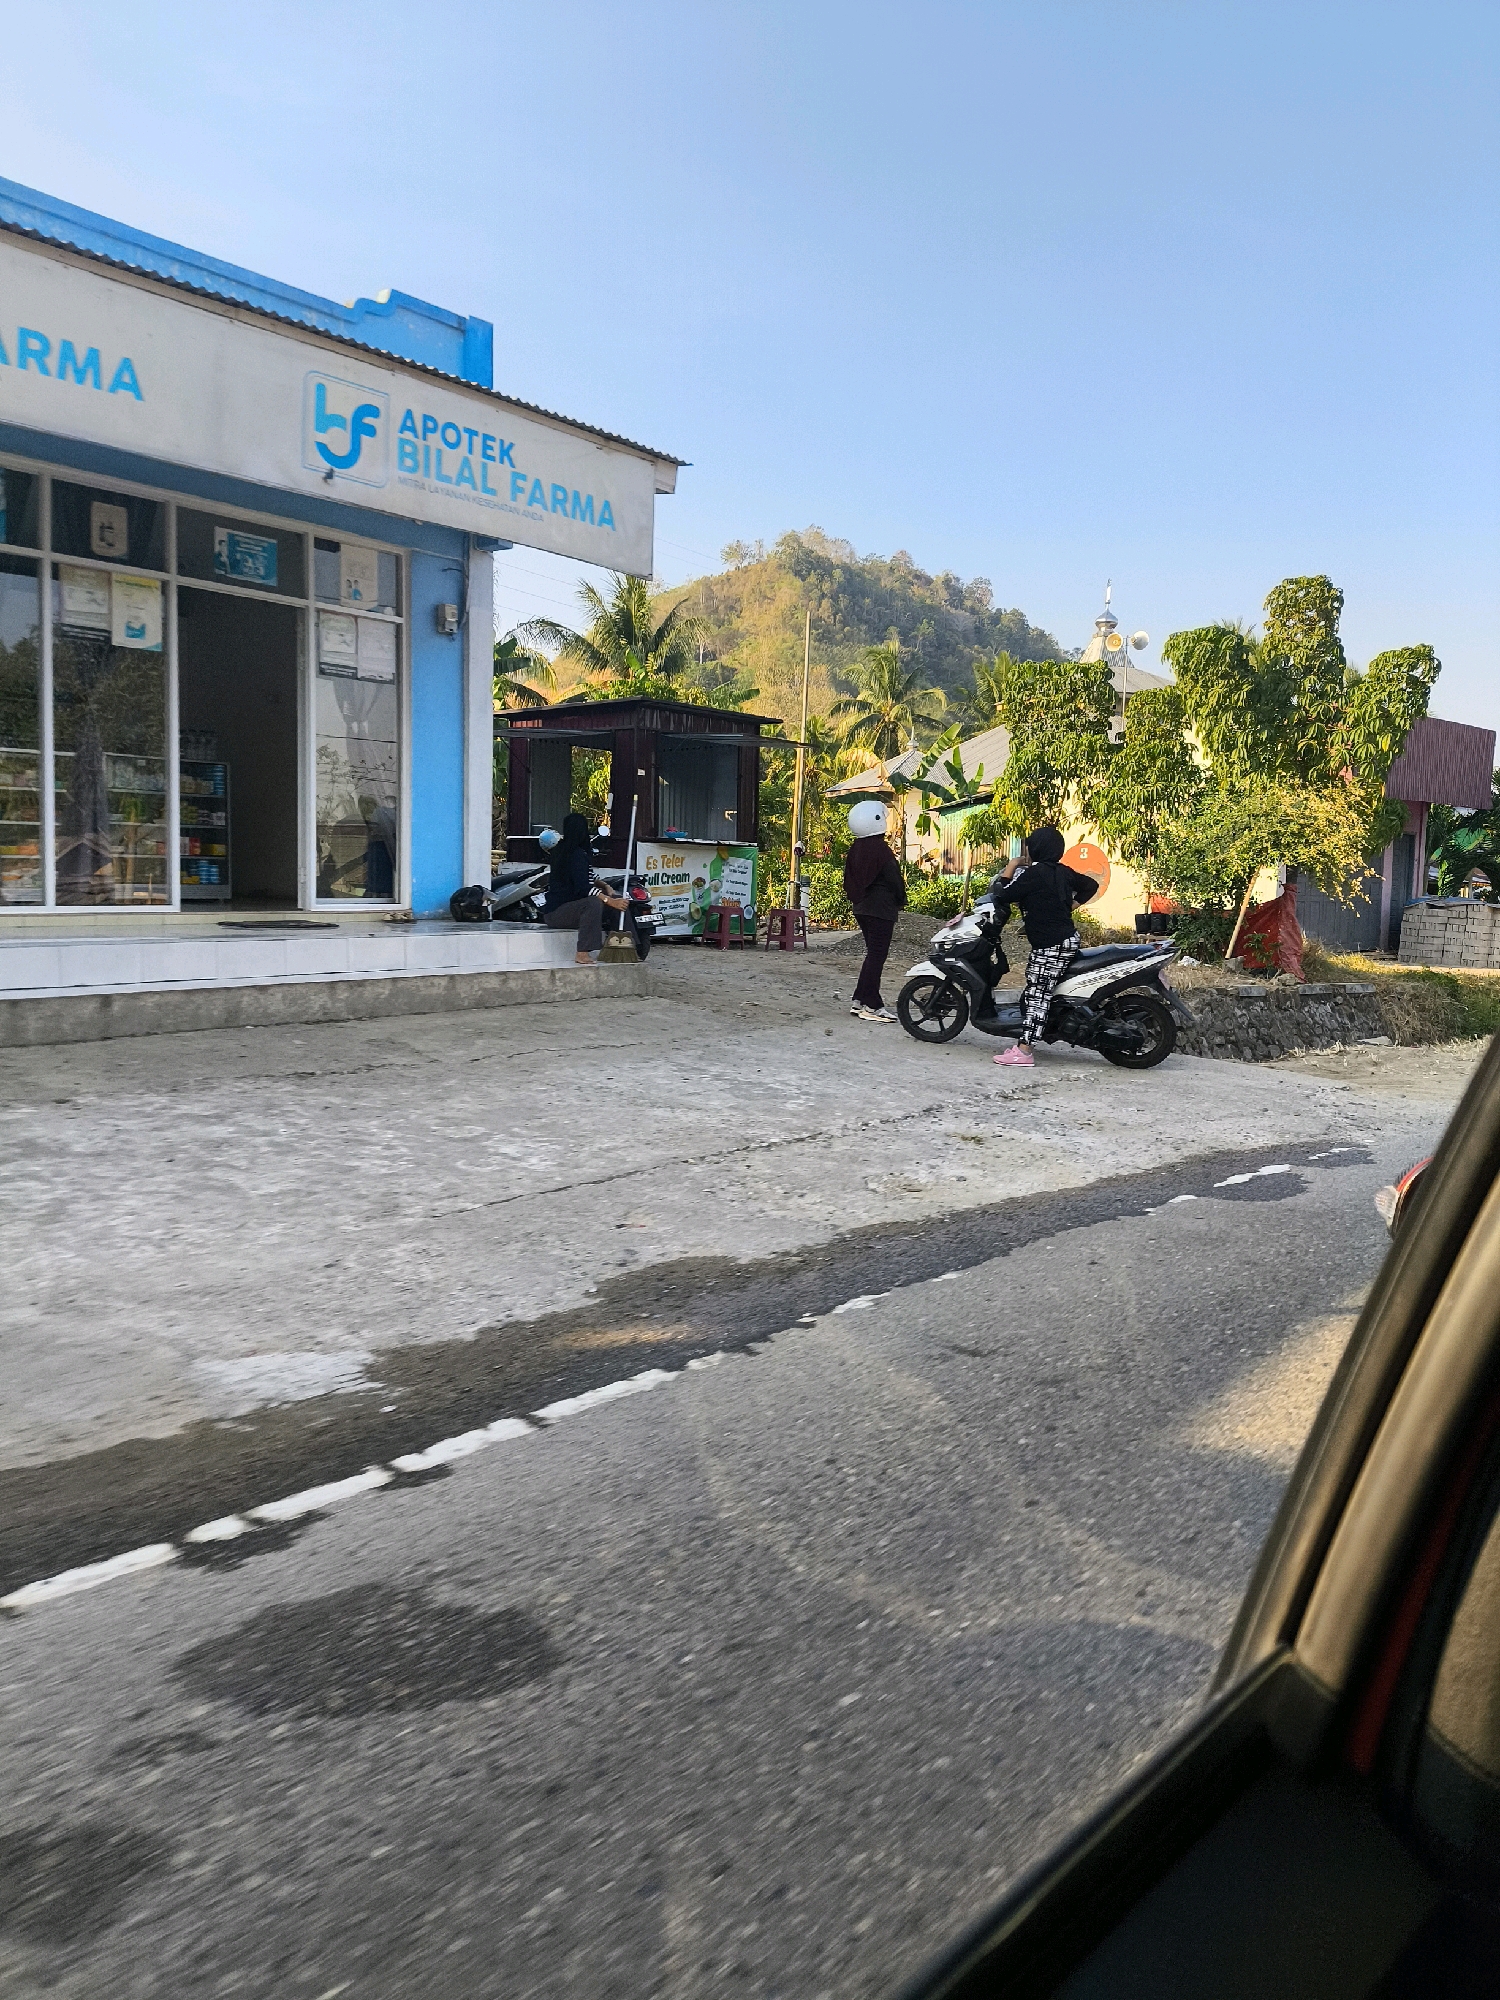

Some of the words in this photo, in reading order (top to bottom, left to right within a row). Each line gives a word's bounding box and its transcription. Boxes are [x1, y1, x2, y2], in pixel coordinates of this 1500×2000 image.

[0, 326, 144, 402] RMA
[398, 408, 516, 468] APOTEK
[397, 437, 498, 497] BILAL
[510, 470, 616, 532] FARMA
[397, 476, 426, 491] MITRA
[427, 484, 471, 502] LAYANAN
[521, 509, 544, 522] ANDA
[646, 856, 658, 870] Es
[661, 853, 686, 869] Teler
[1080, 847, 1089, 859] 3
[661, 872, 690, 885] Cream
